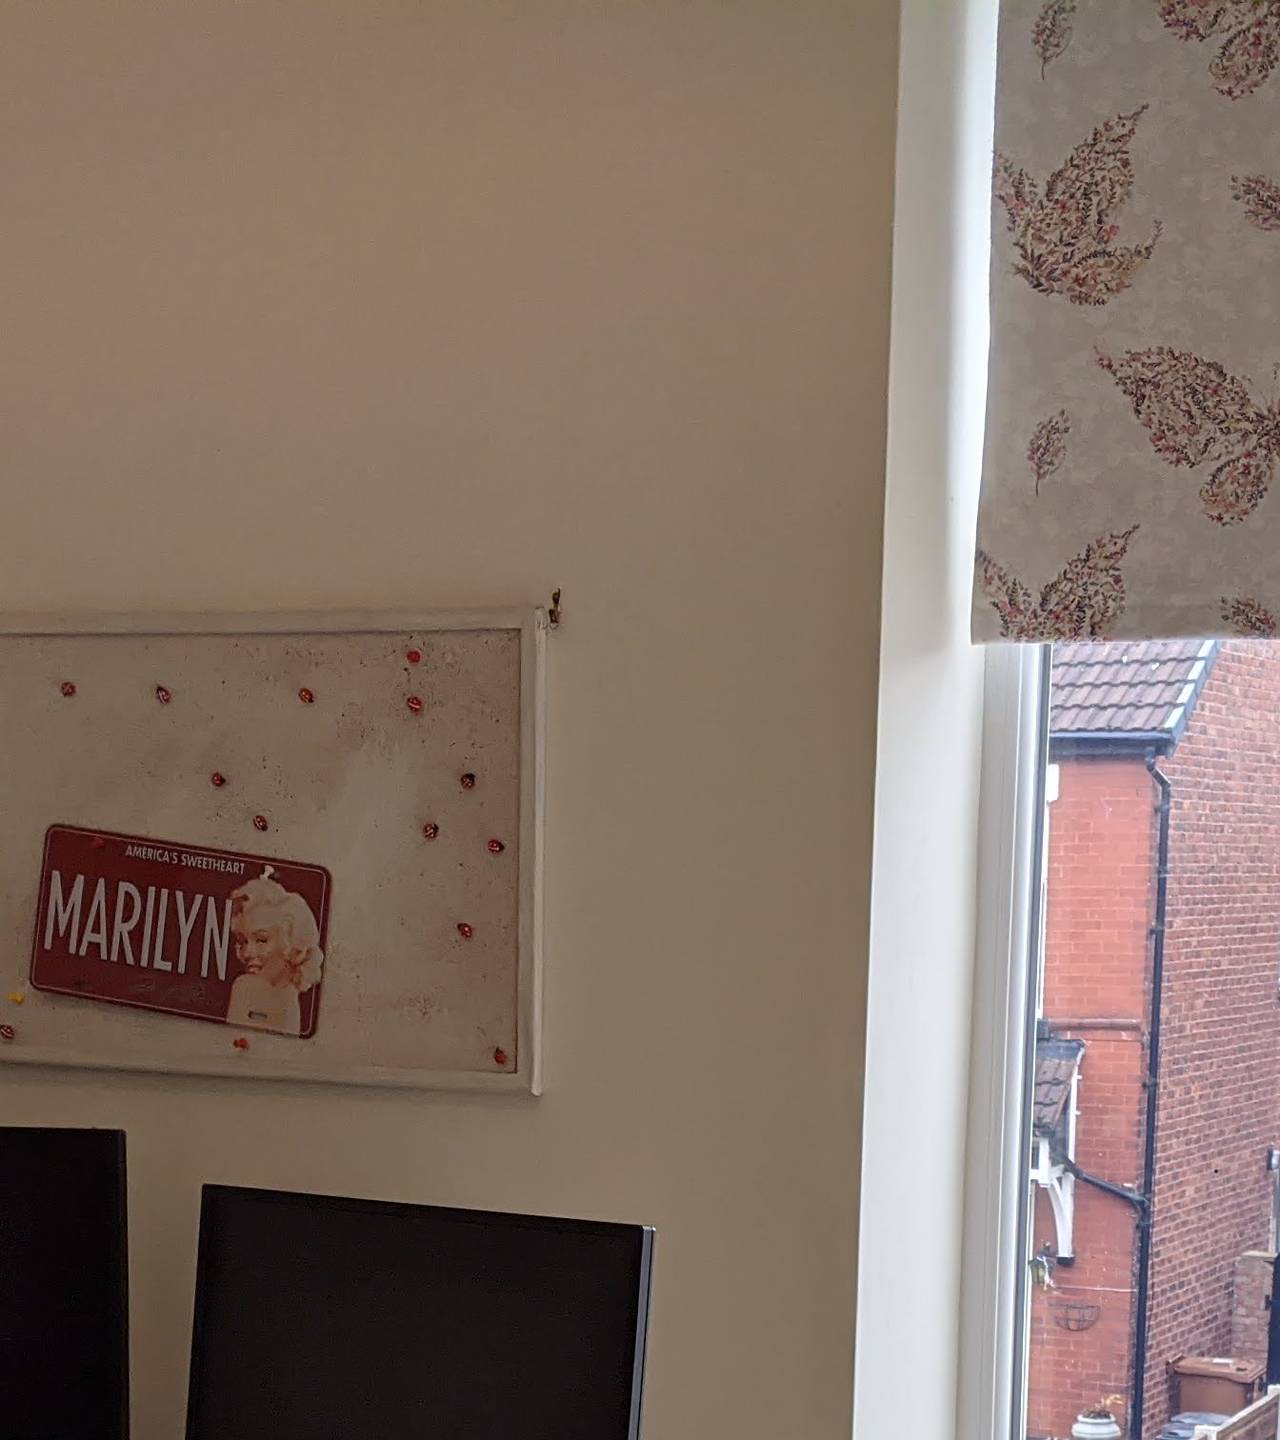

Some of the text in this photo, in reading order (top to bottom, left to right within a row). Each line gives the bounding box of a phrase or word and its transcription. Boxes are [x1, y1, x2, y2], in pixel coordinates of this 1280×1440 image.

[125, 845, 245, 875] AMERICA'S SWEETHEART
[44, 870, 233, 981] MARILYN
